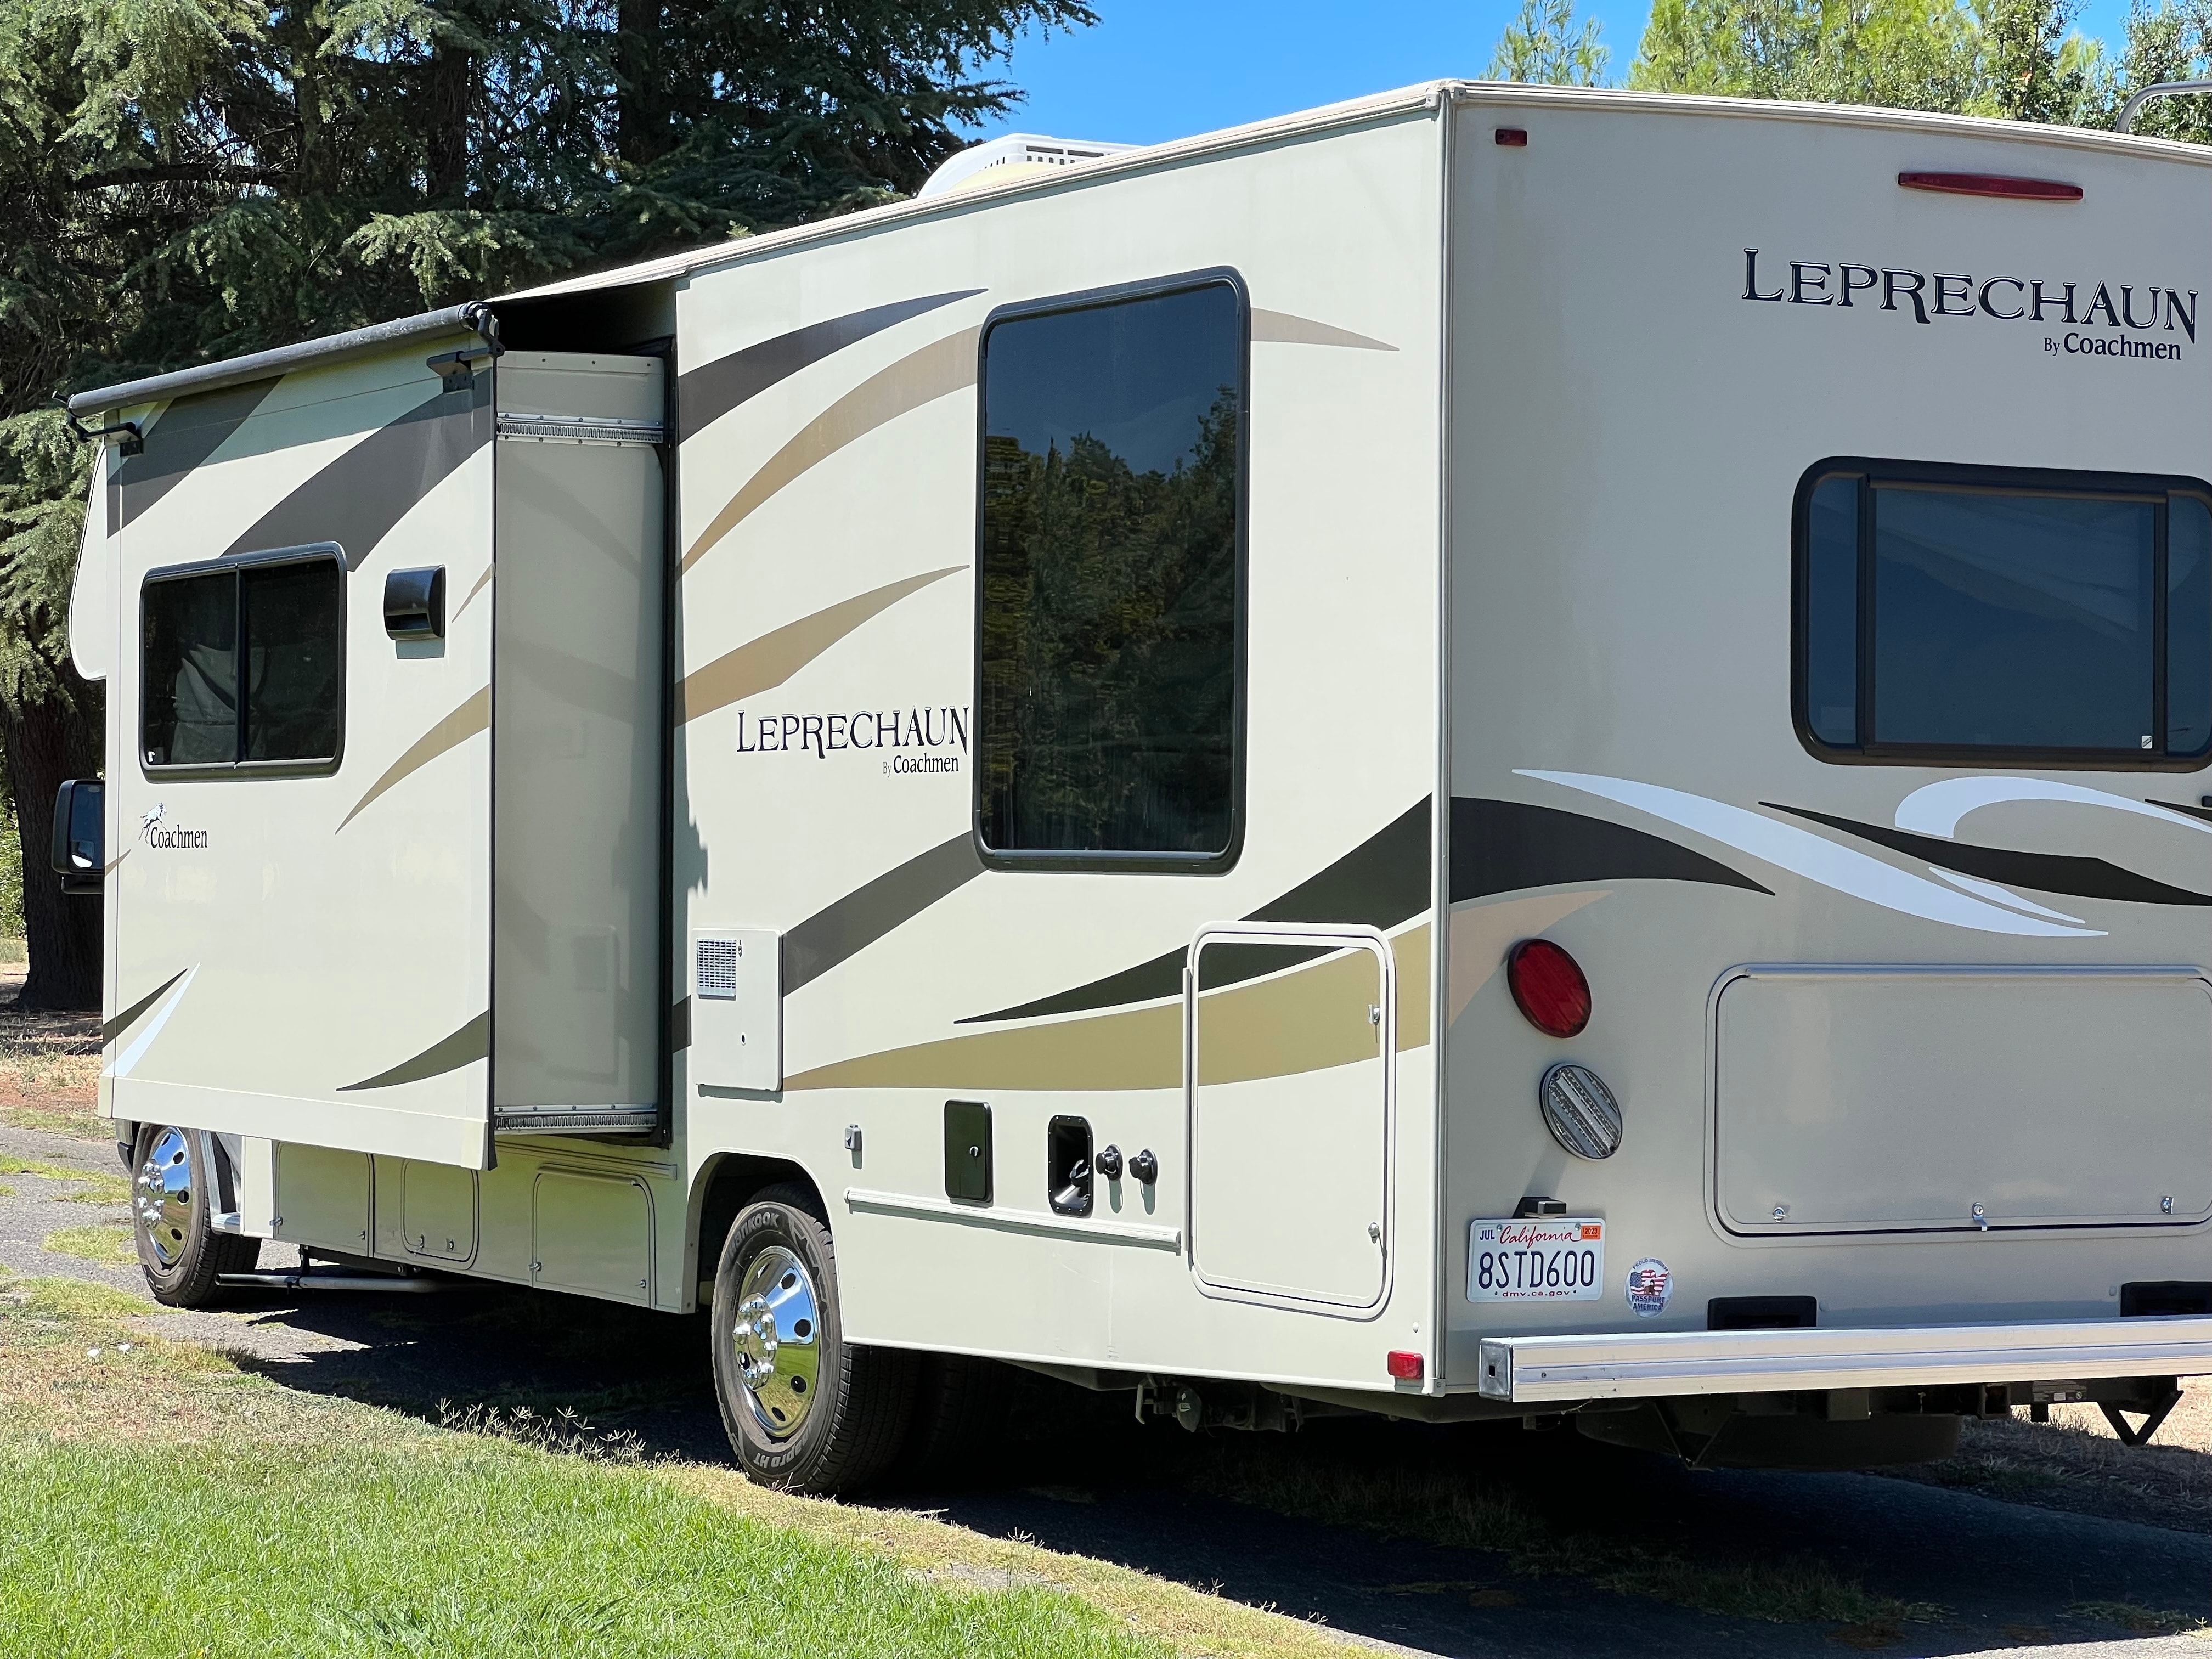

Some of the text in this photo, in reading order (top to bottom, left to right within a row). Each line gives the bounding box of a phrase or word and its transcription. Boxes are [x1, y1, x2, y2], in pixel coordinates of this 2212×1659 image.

[1742, 247, 2198, 344] LEPRECHAUN
[2044, 332, 2181, 360] By Coachmen
[737, 705, 969, 759] LEPRECHAUN
[883, 753, 959, 778] By Coachmen
[150, 823, 208, 848] Coachmen
[1480, 1229, 1495, 1240] JUL
[1499, 1225, 1581, 1249] California
[1479, 1250, 1595, 1289] 8STD600
[1633, 1259, 1648, 1269] PROUD
[1631, 1295, 1665, 1303] PASSPORT
[1633, 1303, 1663, 1312] AMERICA
[753, 1452, 770, 1469] HT
